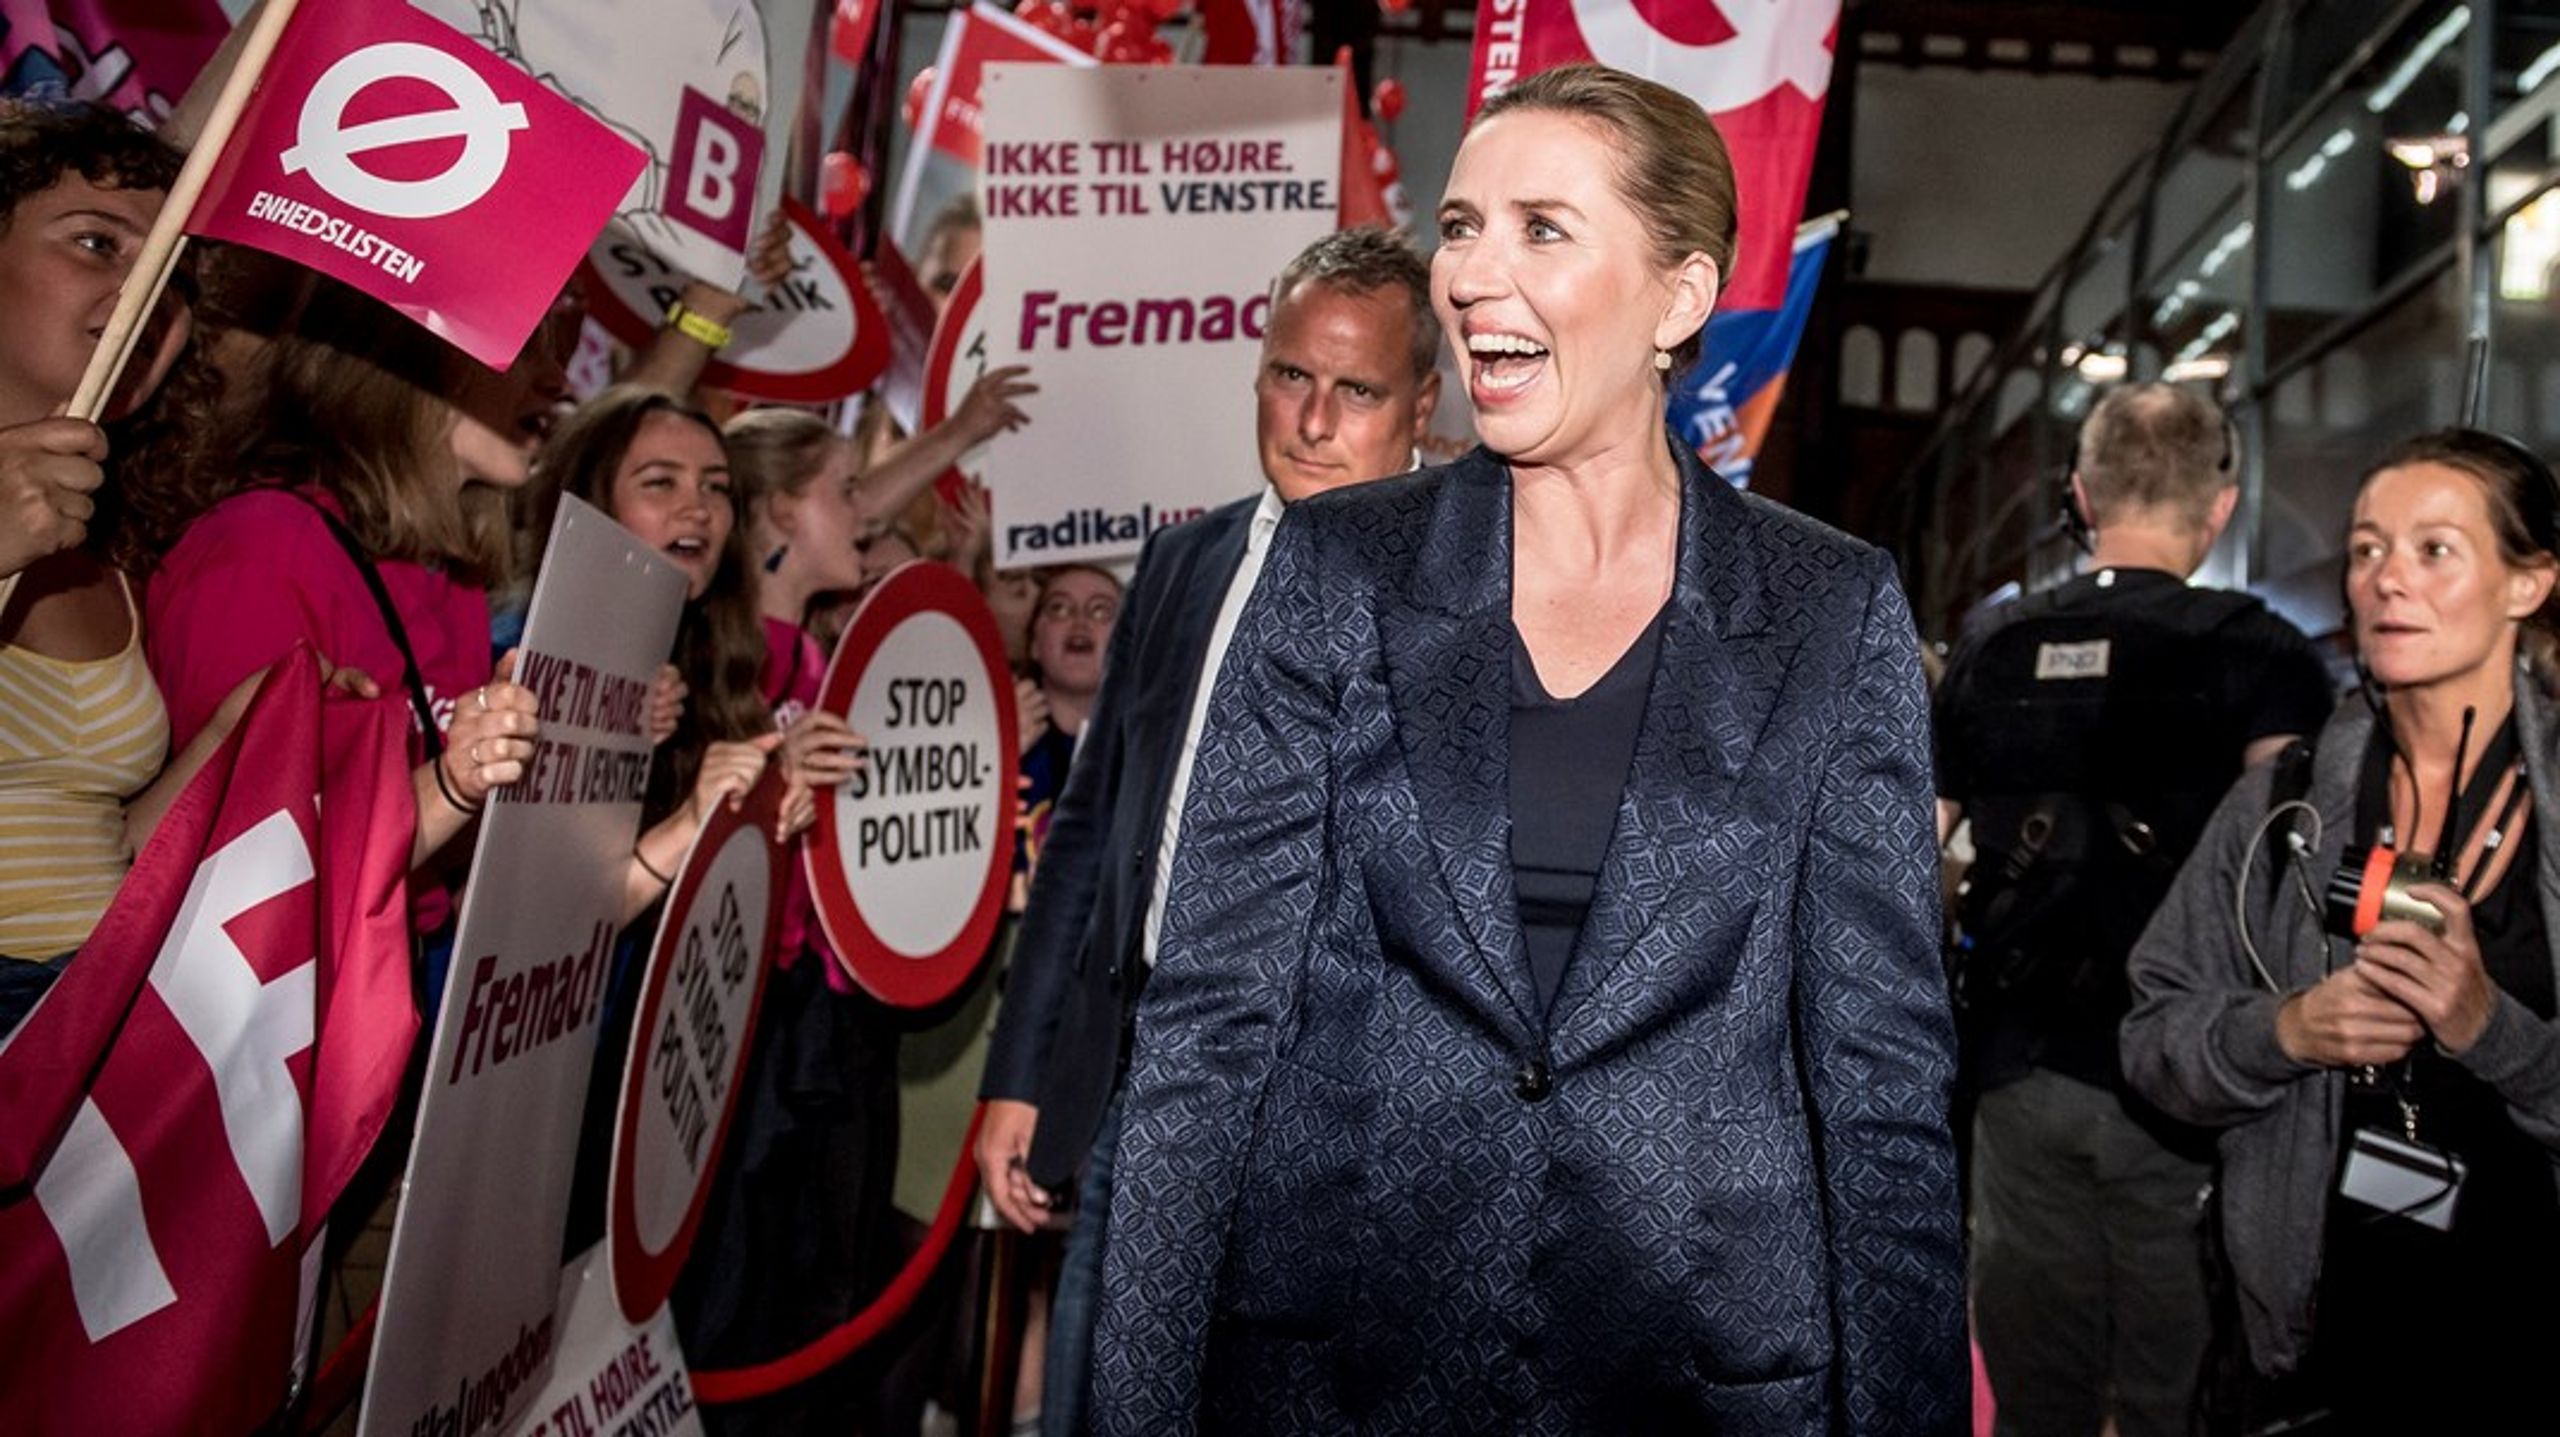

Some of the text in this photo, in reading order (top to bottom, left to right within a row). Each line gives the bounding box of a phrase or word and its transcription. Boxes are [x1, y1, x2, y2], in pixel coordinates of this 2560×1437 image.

[684, 115, 741, 222] B
[986, 140, 1294, 176] IKKE TIL HØJRE.
[247, 190, 427, 284] ENHEDSLISTEN
[986, 179, 1337, 218] IKKE TIL VENSTRE.
[885, 677, 968, 730] STOP
[850, 742, 992, 799] SYMBOL-
[859, 803, 982, 869] POLITIK
[710, 881, 750, 997] STOP
[449, 917, 614, 1086] Fremad!
[653, 1008, 709, 1176] POLITIK
